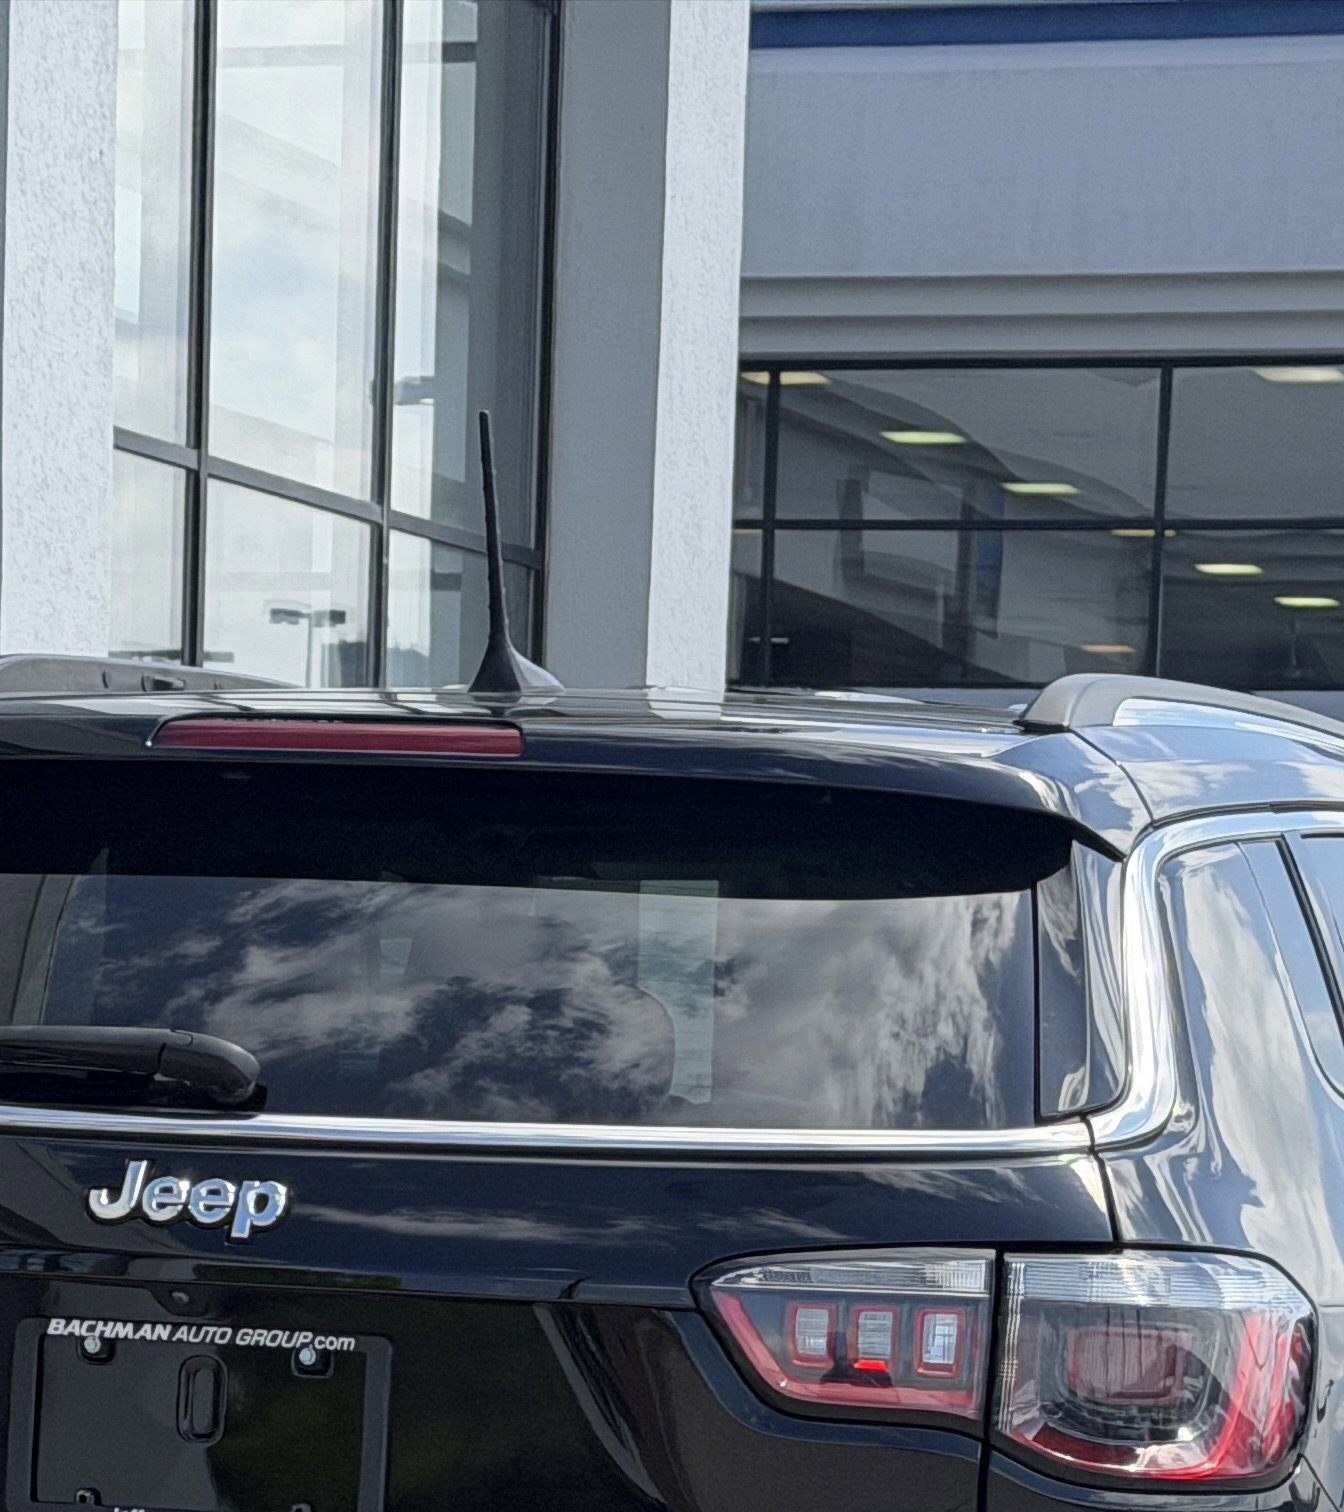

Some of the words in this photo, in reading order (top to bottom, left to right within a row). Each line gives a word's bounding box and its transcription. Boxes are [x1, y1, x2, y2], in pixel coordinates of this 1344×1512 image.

[88, 1159, 288, 1239] Jeep
[46, 1317, 172, 1341] BACHMAN
[172, 1324, 232, 1344] AUTO
